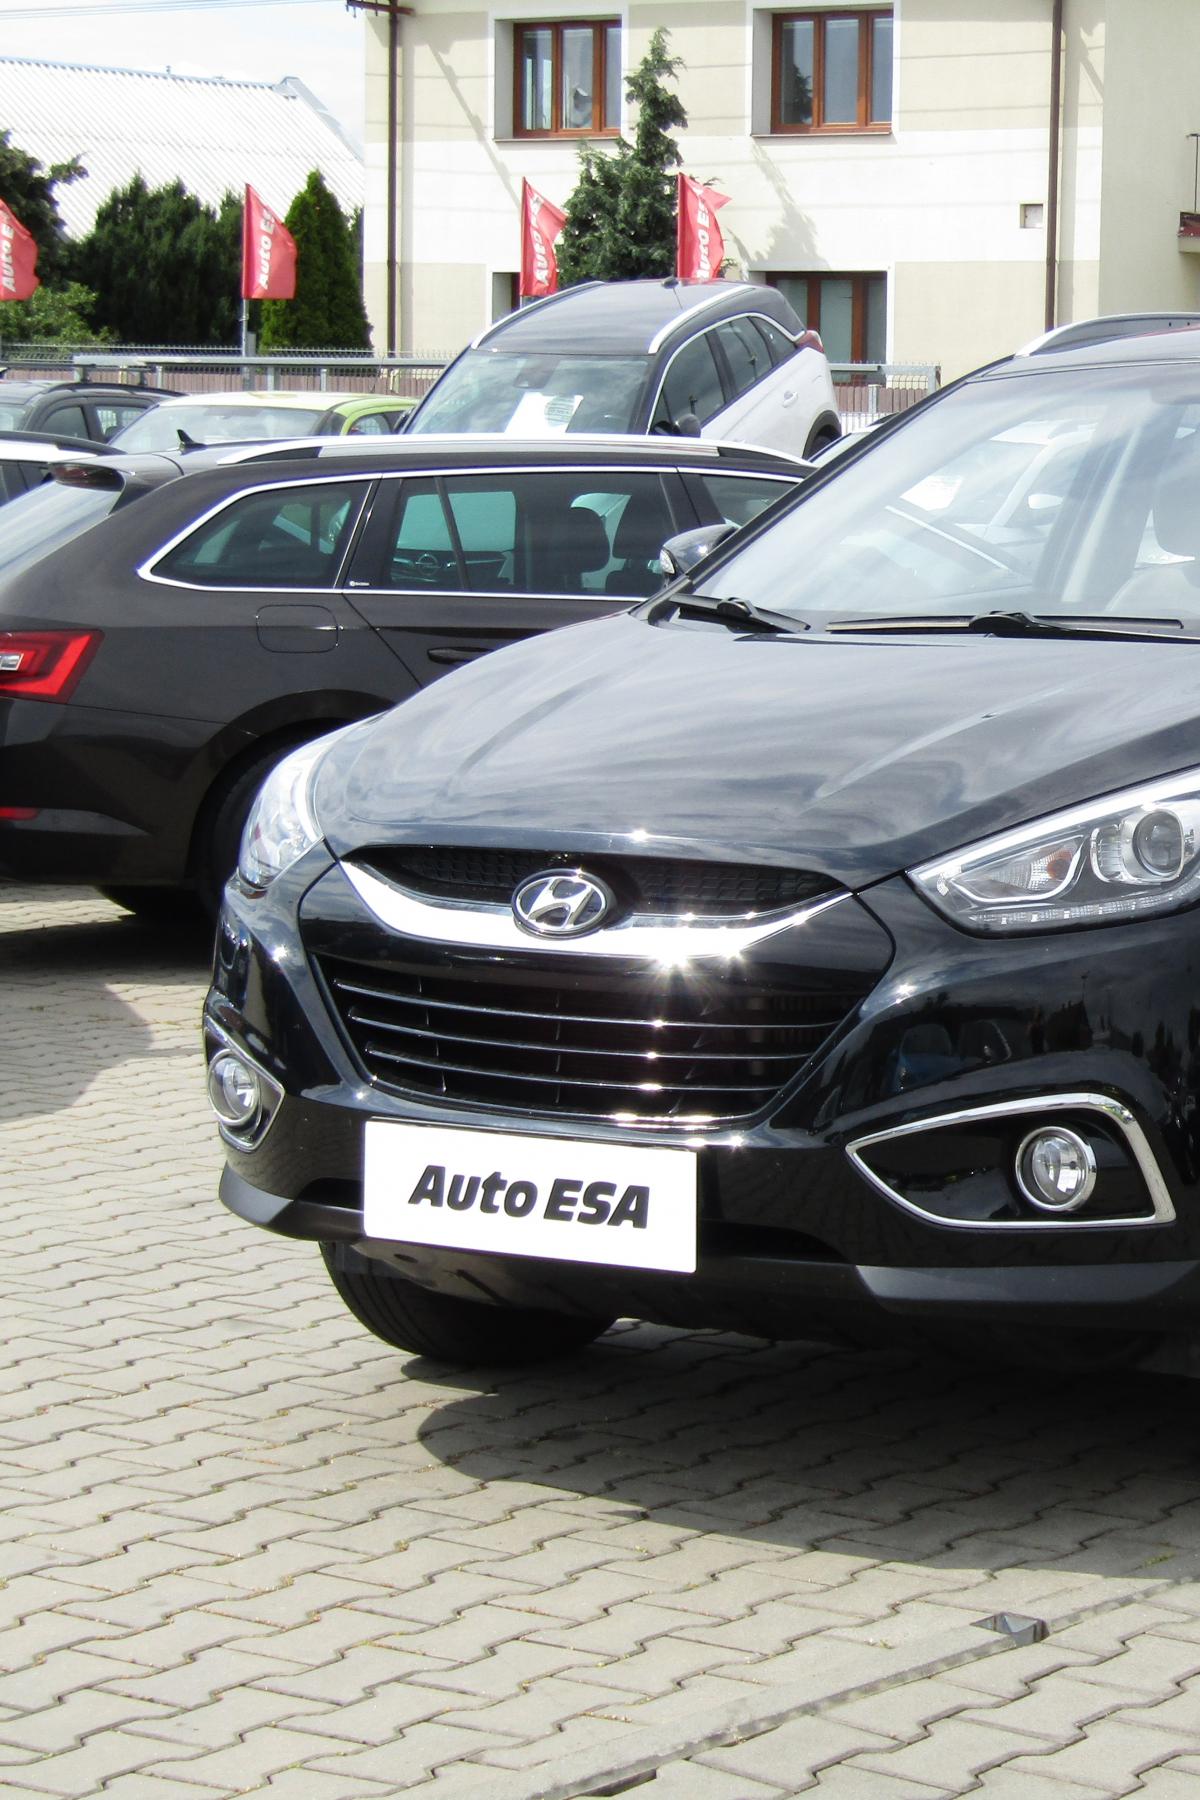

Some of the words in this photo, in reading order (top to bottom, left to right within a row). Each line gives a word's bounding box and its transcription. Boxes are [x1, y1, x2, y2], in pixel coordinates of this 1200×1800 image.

[259, 235, 273, 290] Auto
[407, 1164, 539, 1218] Auto
[543, 1178, 650, 1229] ESA
